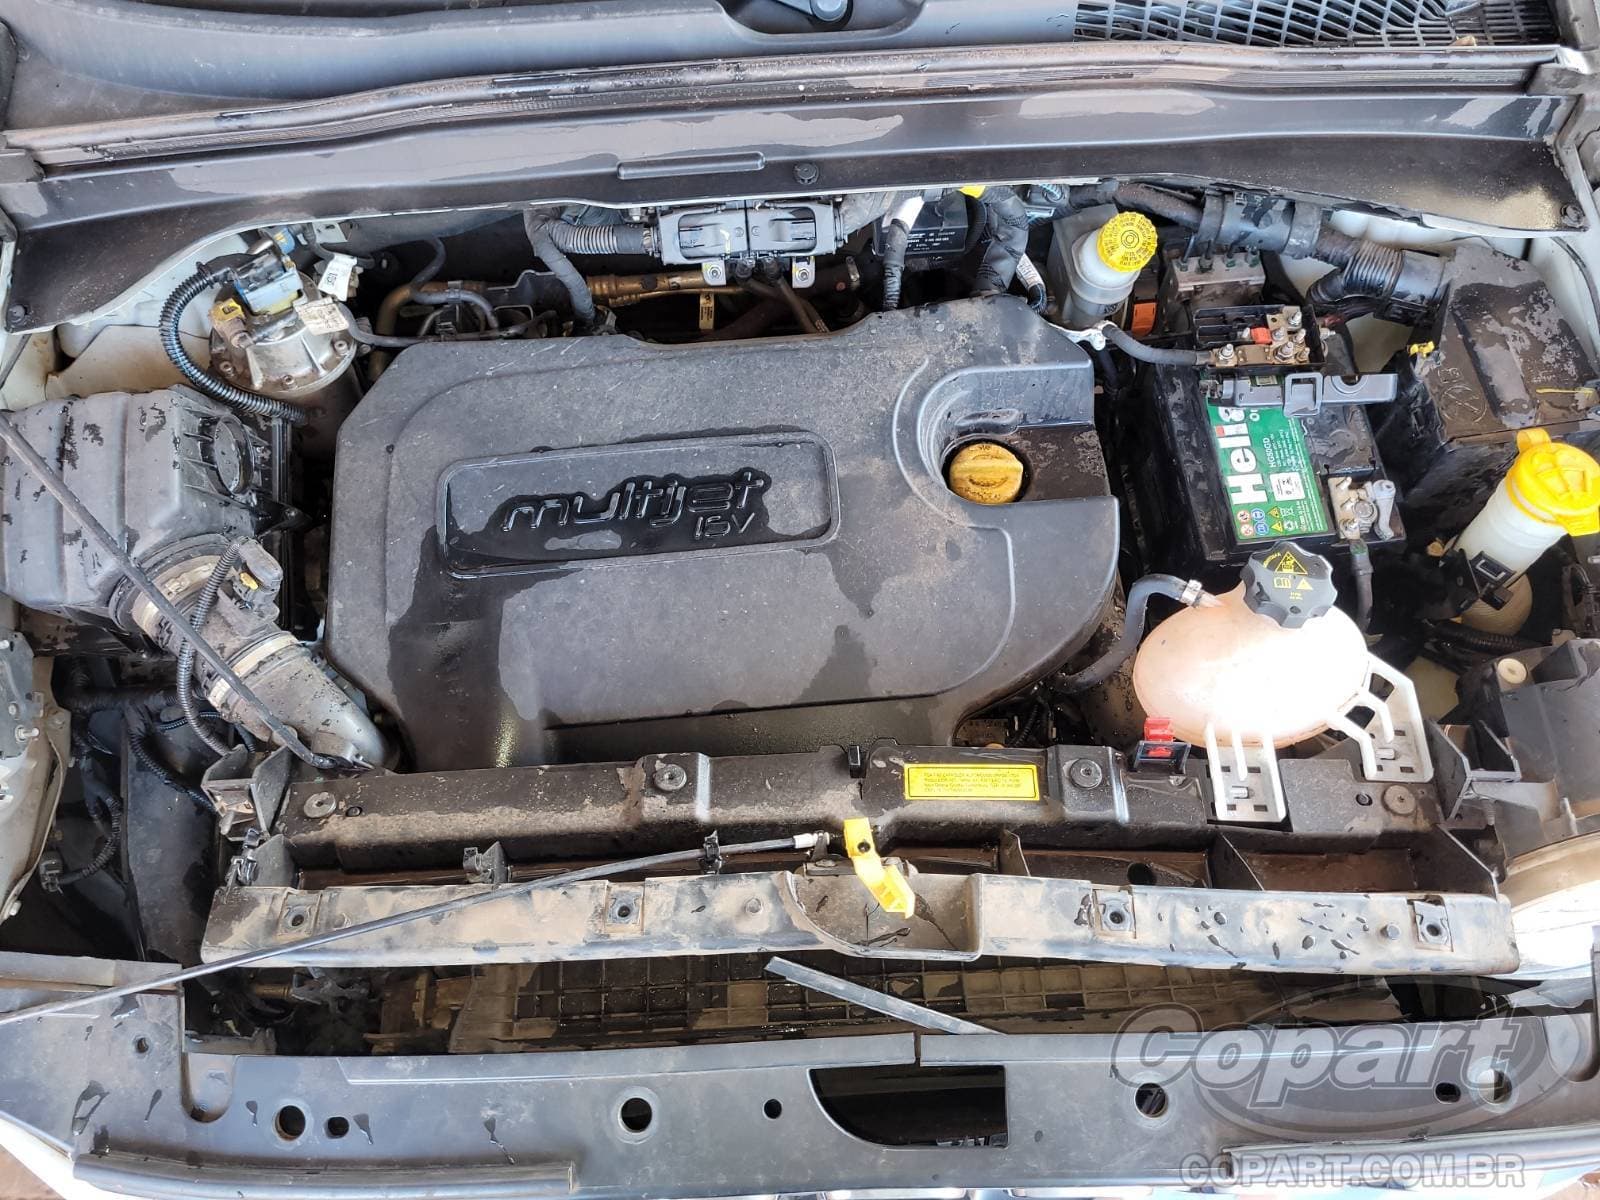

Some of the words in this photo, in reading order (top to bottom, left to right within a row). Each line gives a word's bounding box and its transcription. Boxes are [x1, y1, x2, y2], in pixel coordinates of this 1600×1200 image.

[1215, 407, 1268, 505] Helia
[502, 471, 763, 532] multijet
[694, 512, 755, 540] 16V
